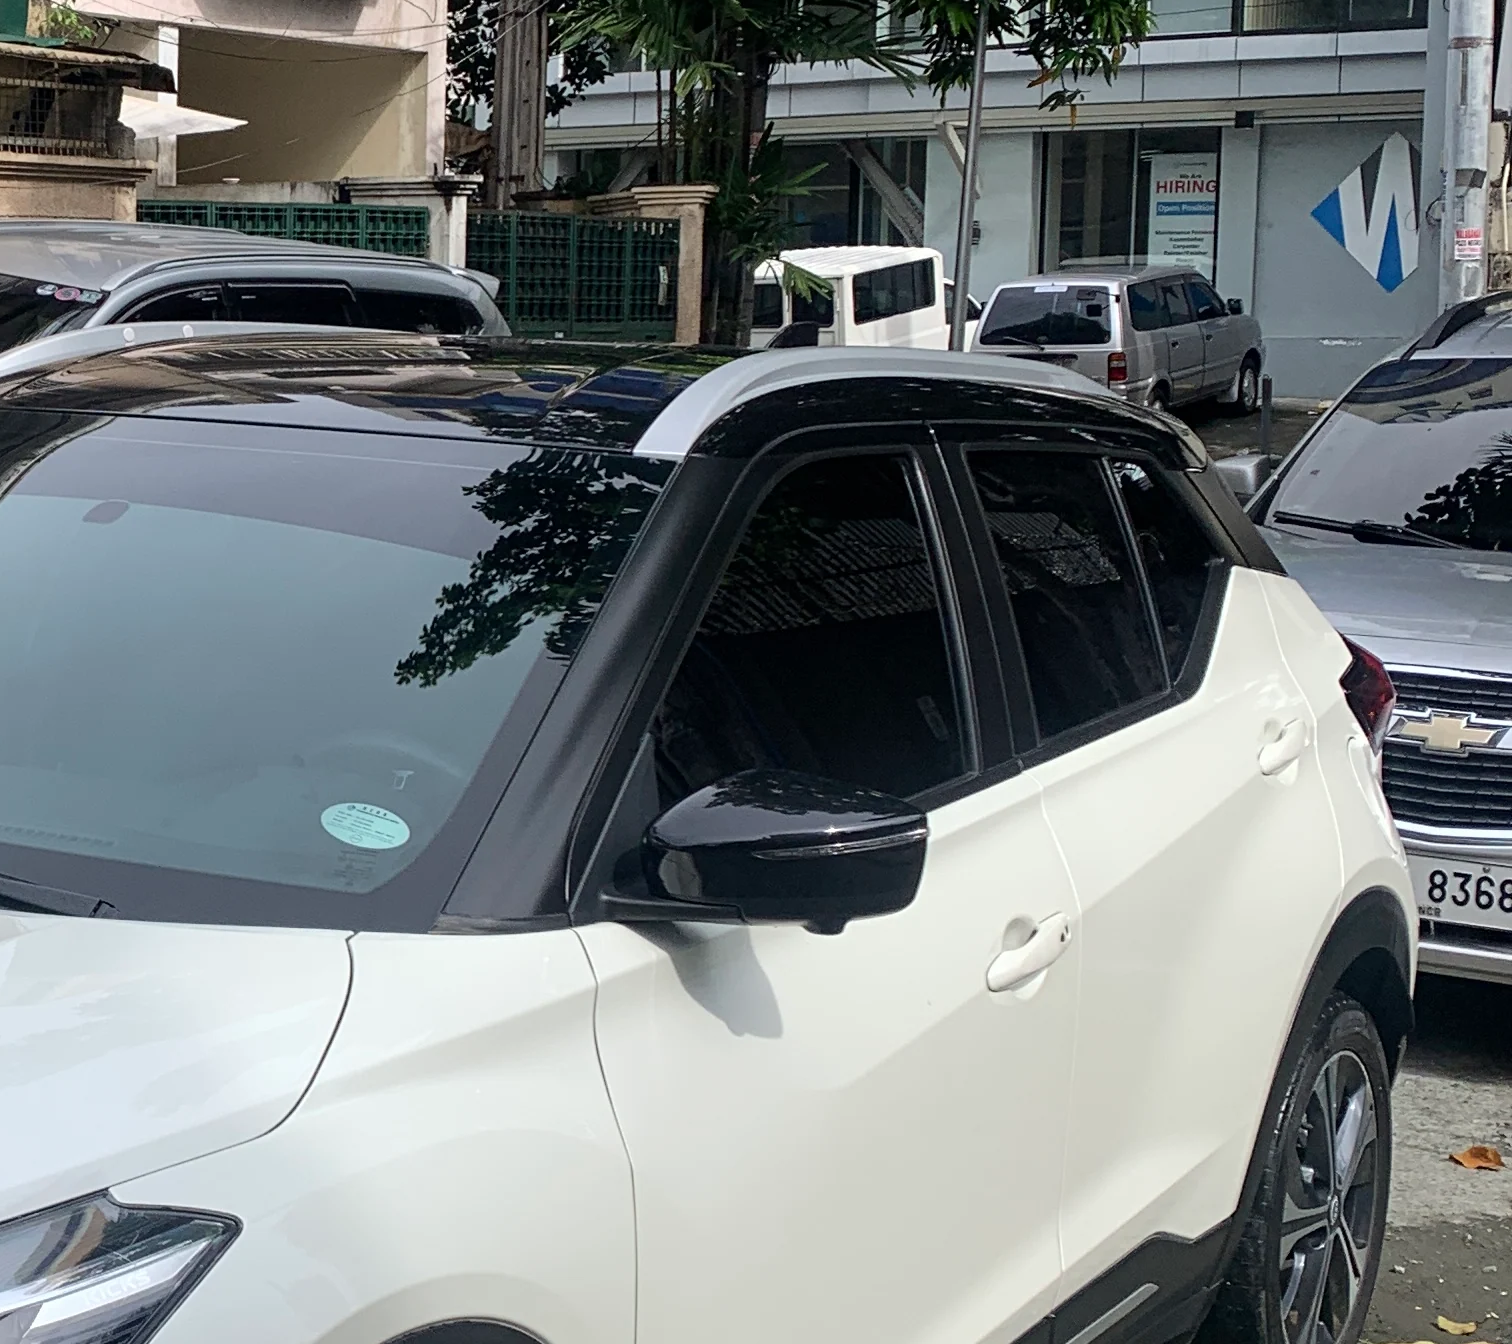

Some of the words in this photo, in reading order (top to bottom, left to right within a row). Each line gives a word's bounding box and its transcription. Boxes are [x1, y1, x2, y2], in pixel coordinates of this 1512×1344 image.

[1155, 179, 1217, 194] HIRING
[1428, 869, 1512, 914] 8368
[84, 1269, 151, 1305] KICKS
